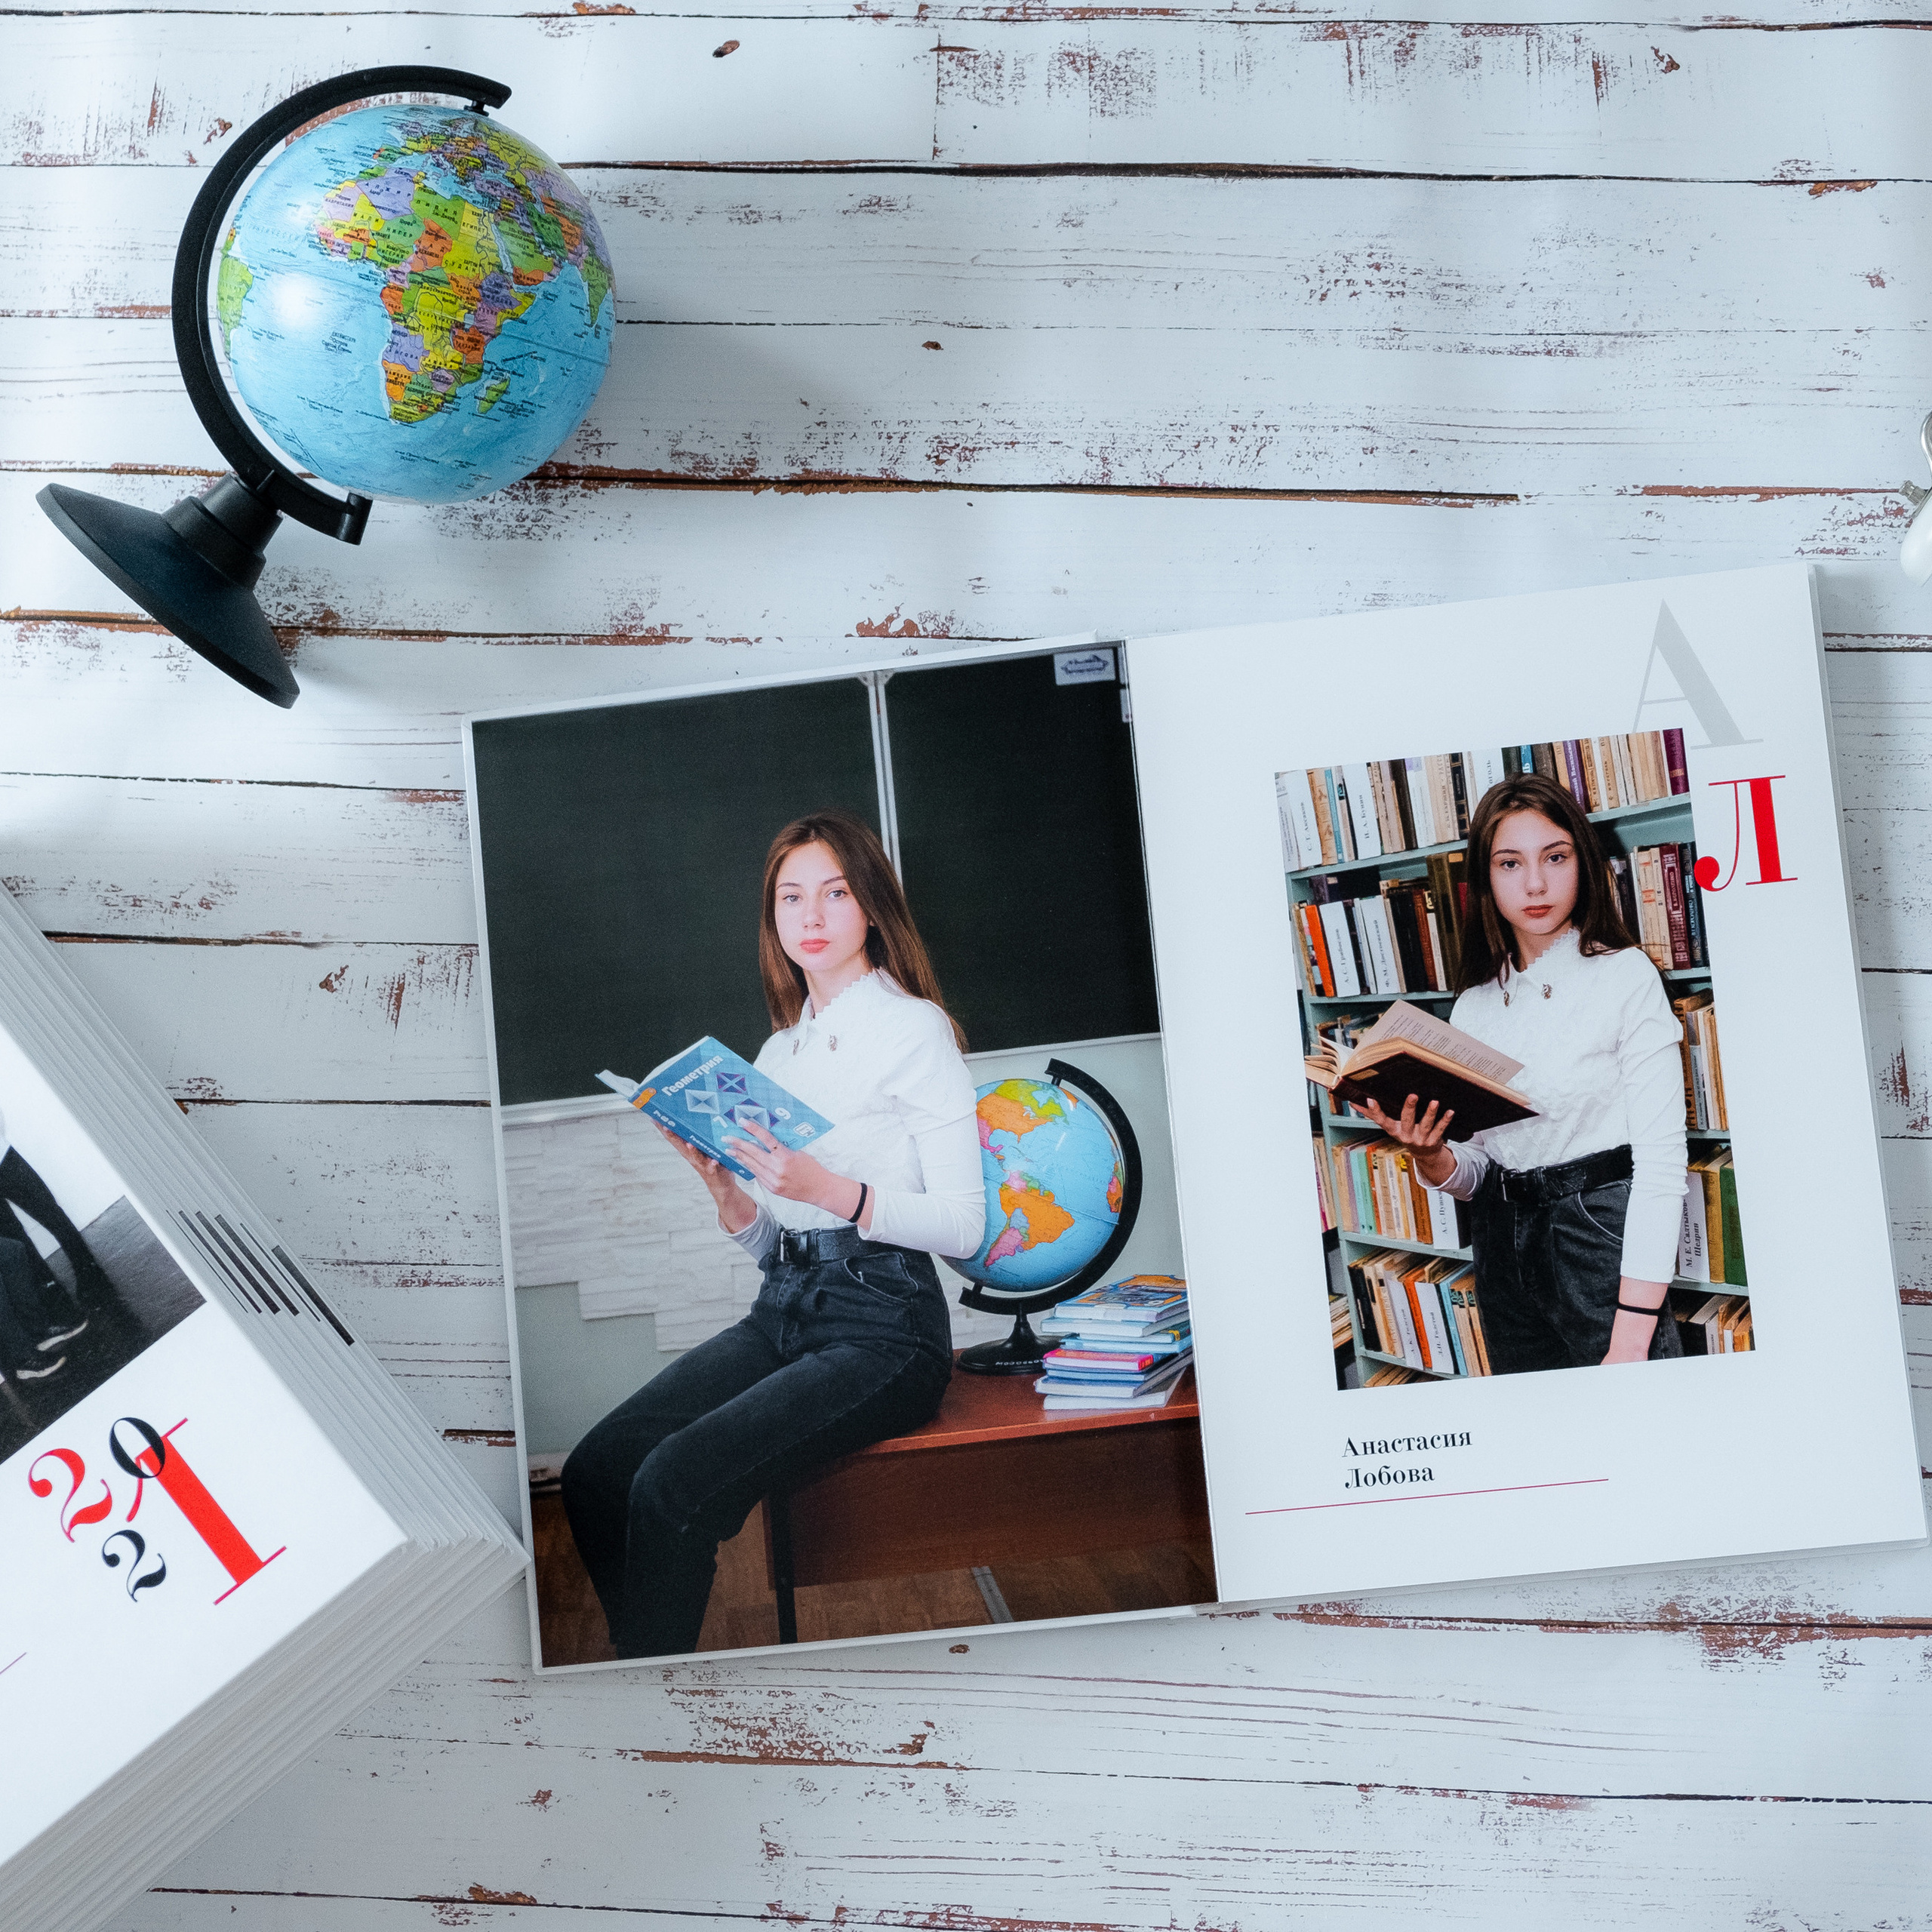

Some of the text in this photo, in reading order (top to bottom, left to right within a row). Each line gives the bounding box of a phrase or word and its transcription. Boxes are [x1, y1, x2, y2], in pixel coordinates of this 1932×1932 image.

[661, 1054, 724, 1097] Геометрия
[1341, 1431, 1473, 1458] Анастасия
[1344, 1466, 1435, 1490] Лобова
